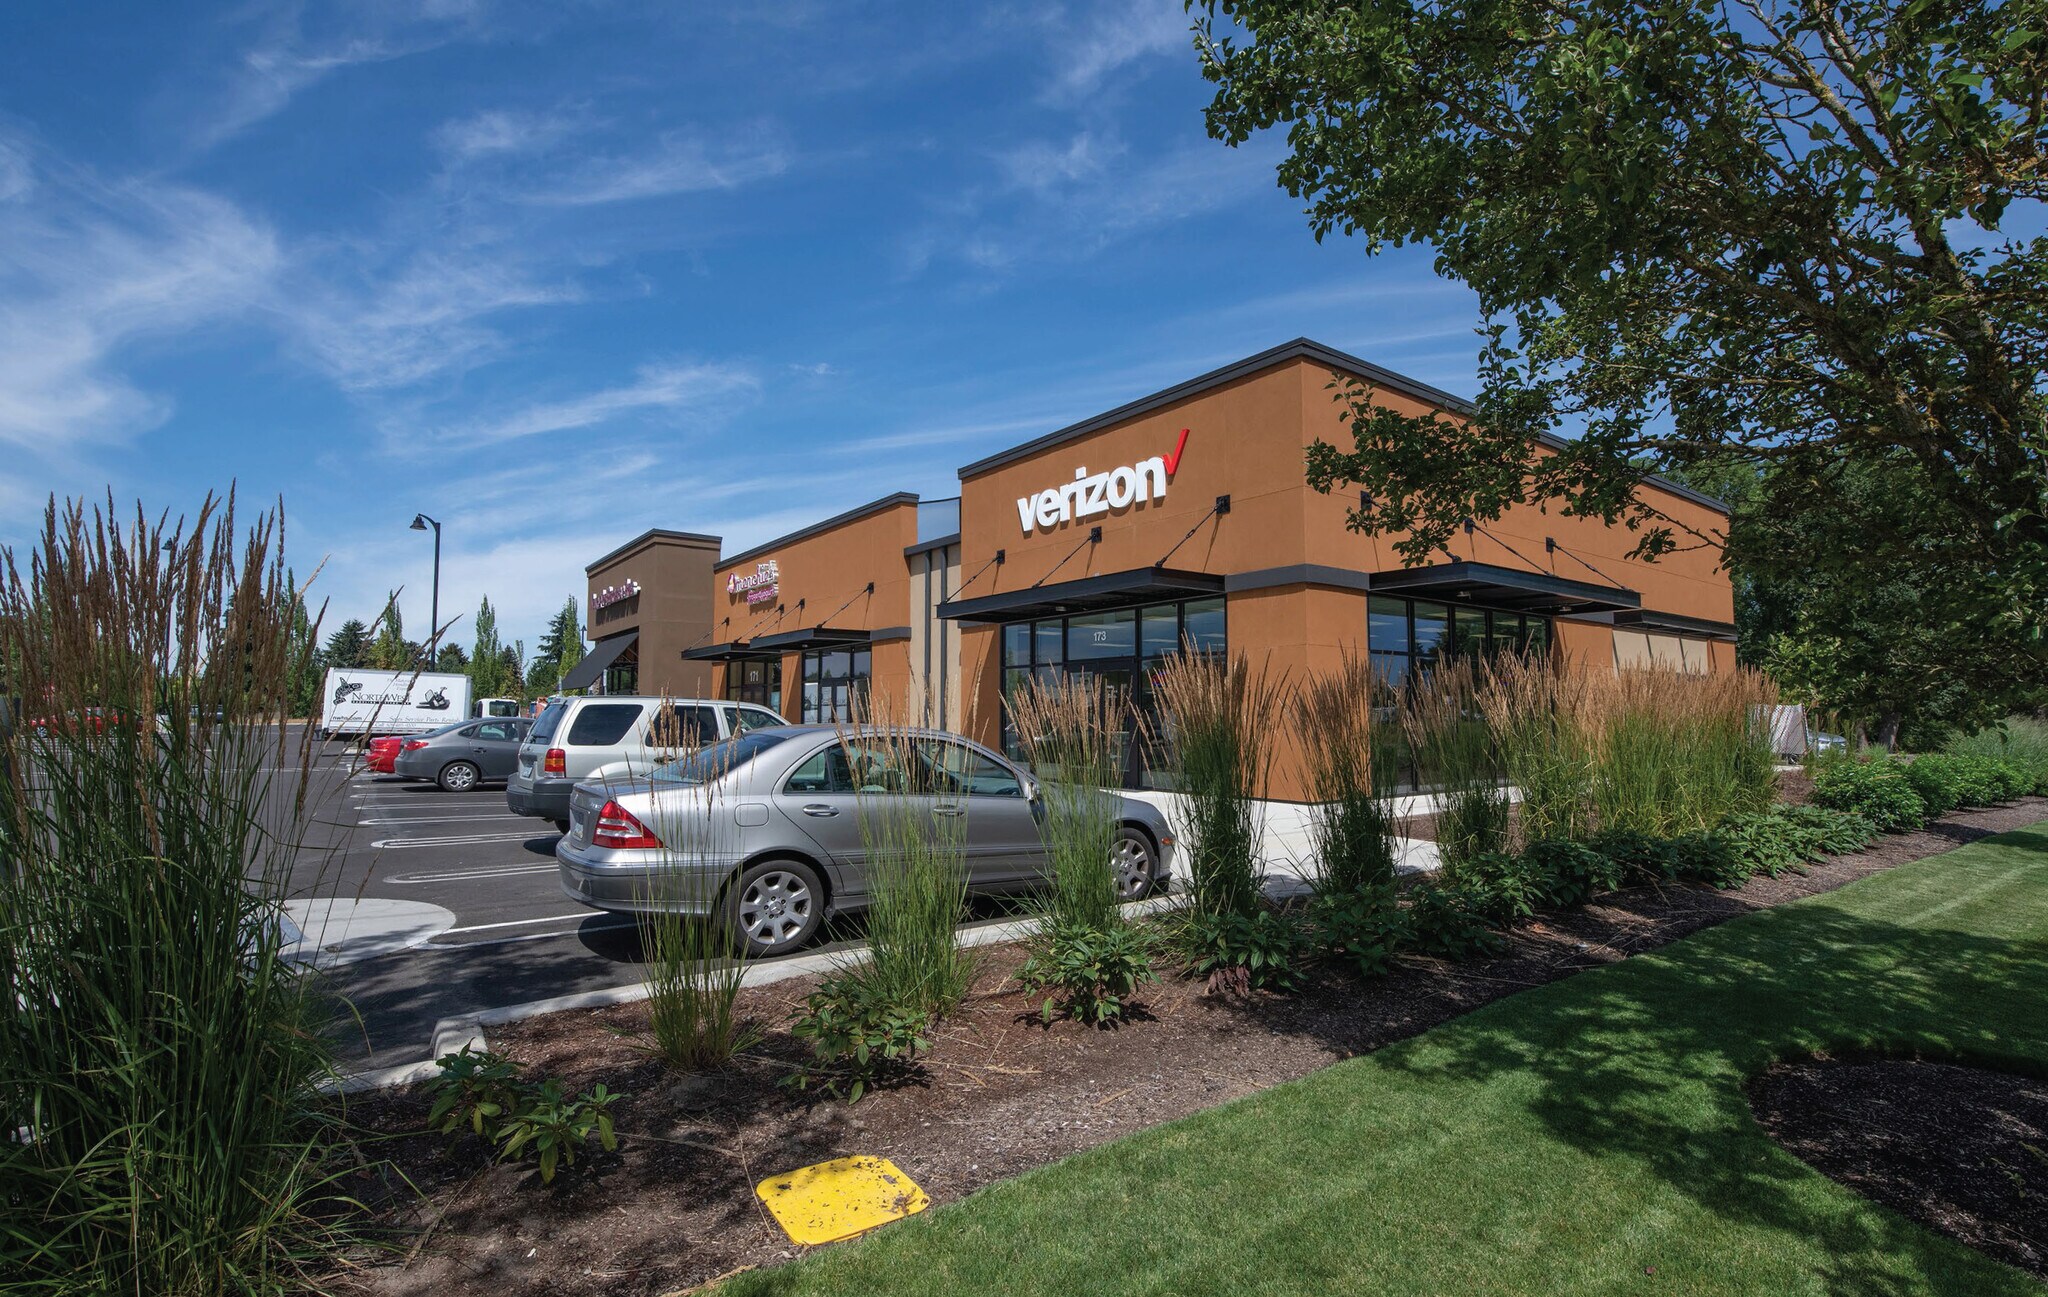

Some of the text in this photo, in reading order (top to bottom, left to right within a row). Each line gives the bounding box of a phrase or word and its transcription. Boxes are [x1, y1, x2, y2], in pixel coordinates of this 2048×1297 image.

[1017, 456, 1167, 532] verizon
[1093, 631, 1107, 641] 173
[749, 670, 759, 682] 171
